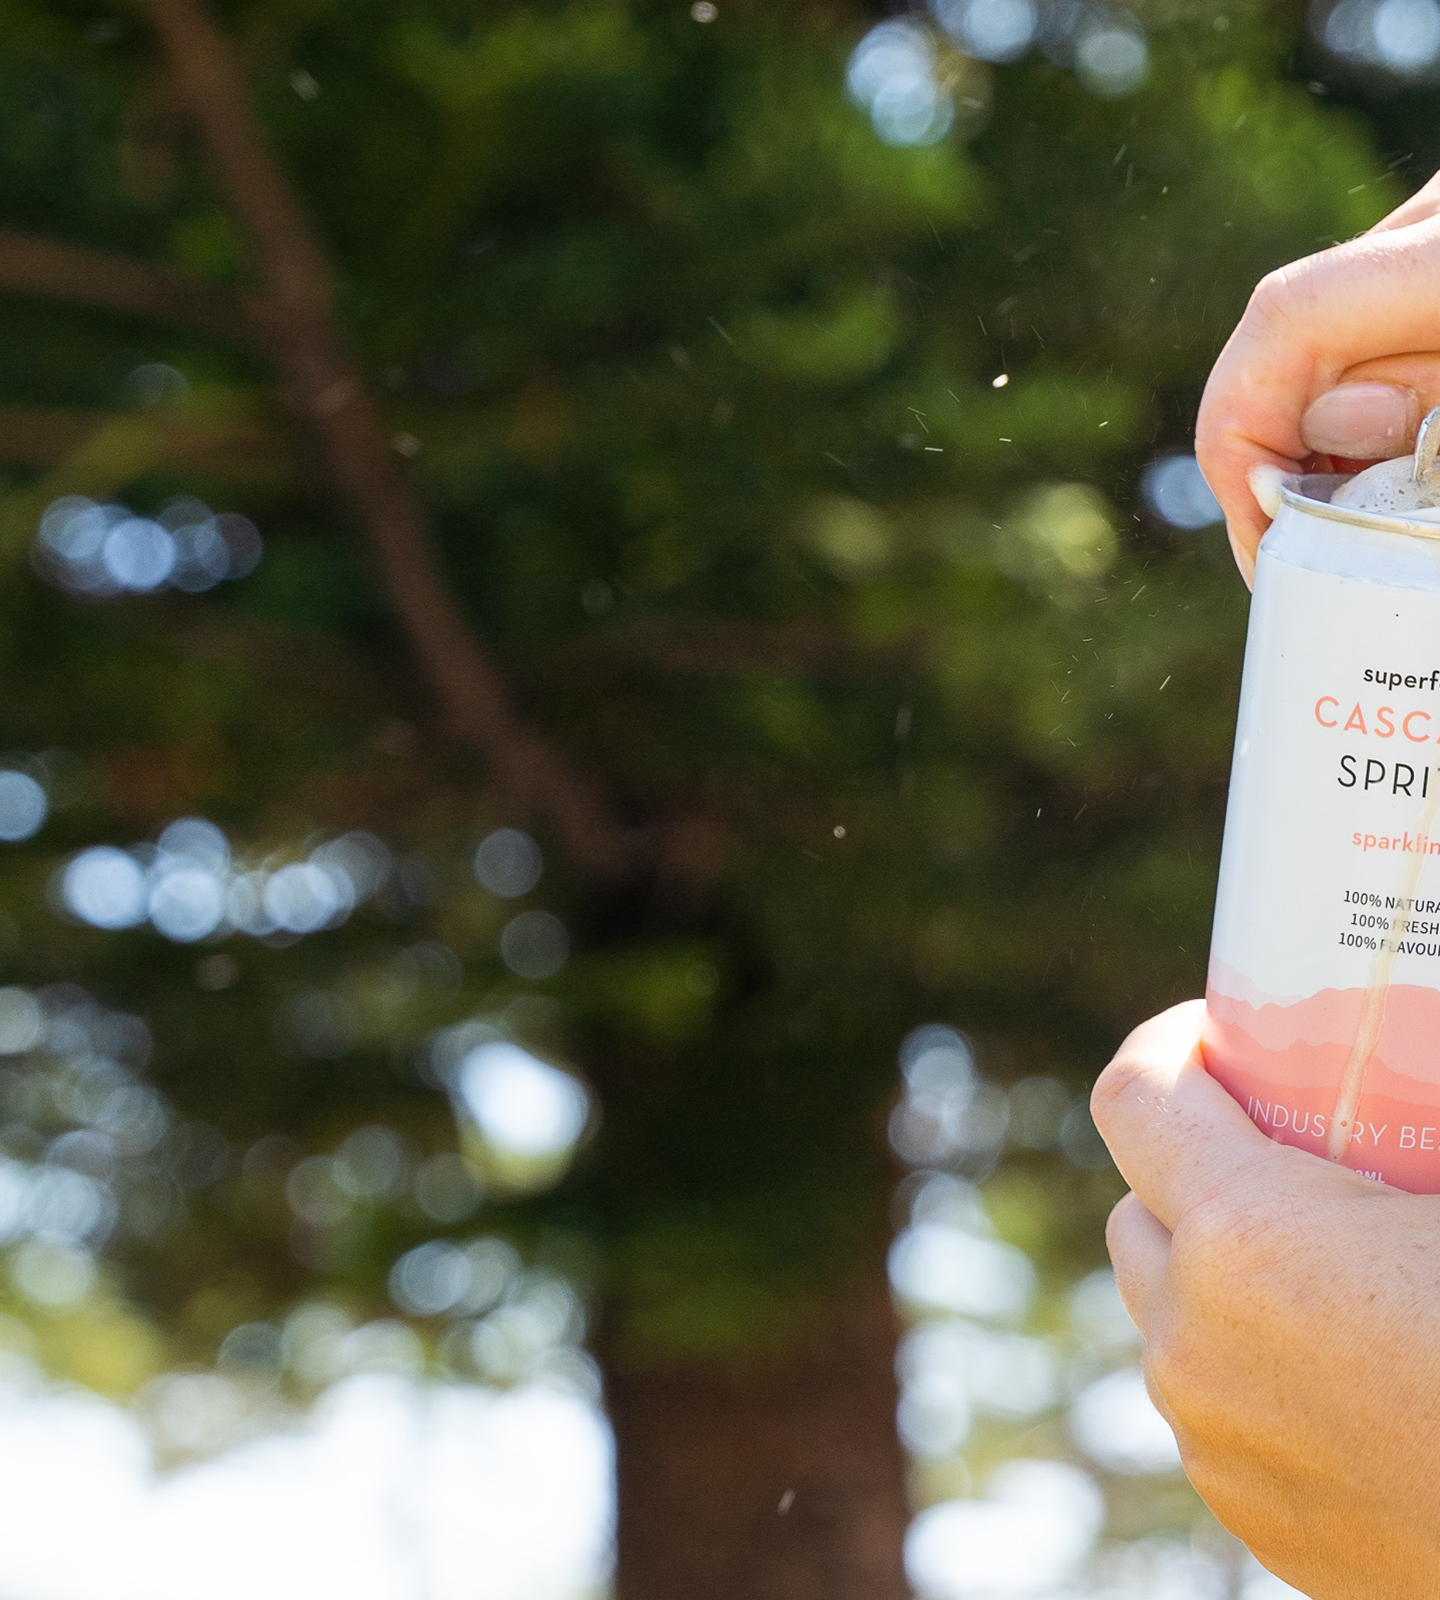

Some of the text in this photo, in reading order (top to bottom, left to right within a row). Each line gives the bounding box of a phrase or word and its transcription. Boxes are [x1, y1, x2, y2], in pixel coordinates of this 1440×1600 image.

[1343, 890, 1382, 908] 100%
[1350, 913, 1389, 931] 100%
[1338, 932, 1377, 950] 100%
[1246, 1095, 1388, 1147] INDUSRY
